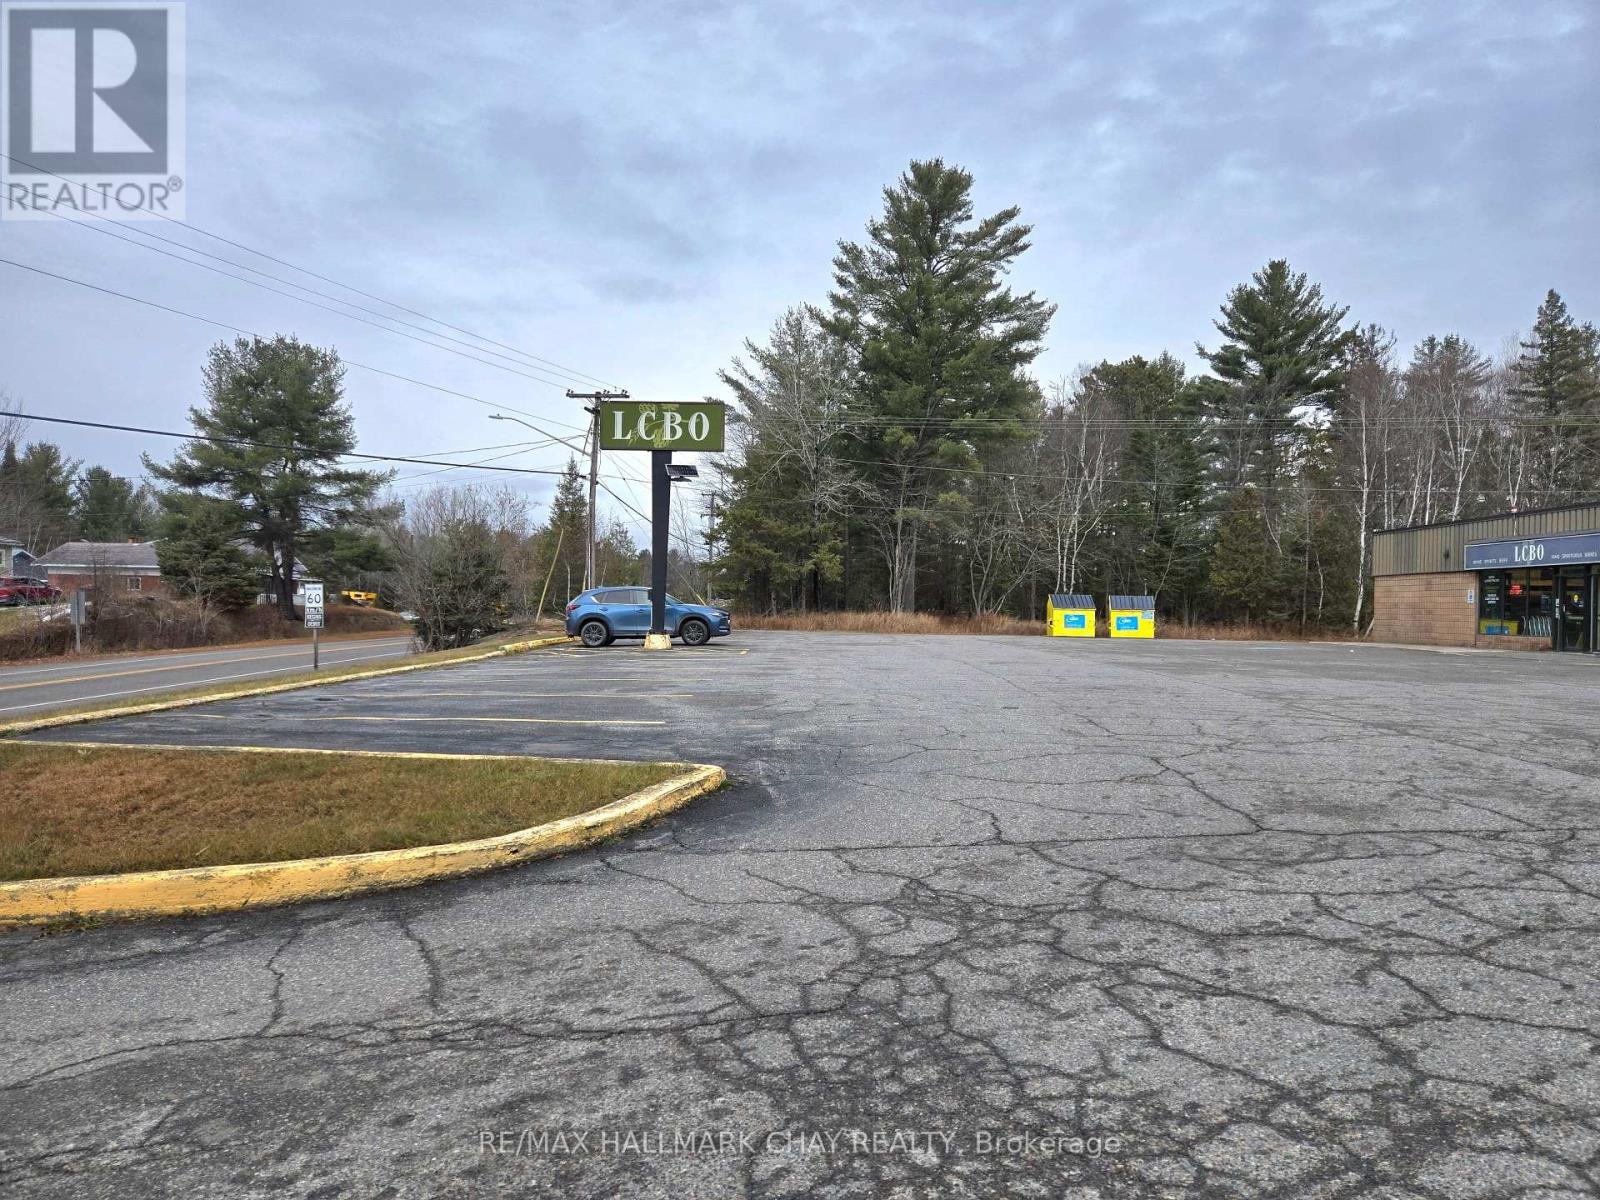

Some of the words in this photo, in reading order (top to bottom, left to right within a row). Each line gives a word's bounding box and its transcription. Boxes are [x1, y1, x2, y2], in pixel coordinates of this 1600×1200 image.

[612, 410, 710, 441] LCBO
[1514, 544, 1544, 561] LCBO
[307, 593, 321, 604] 60
